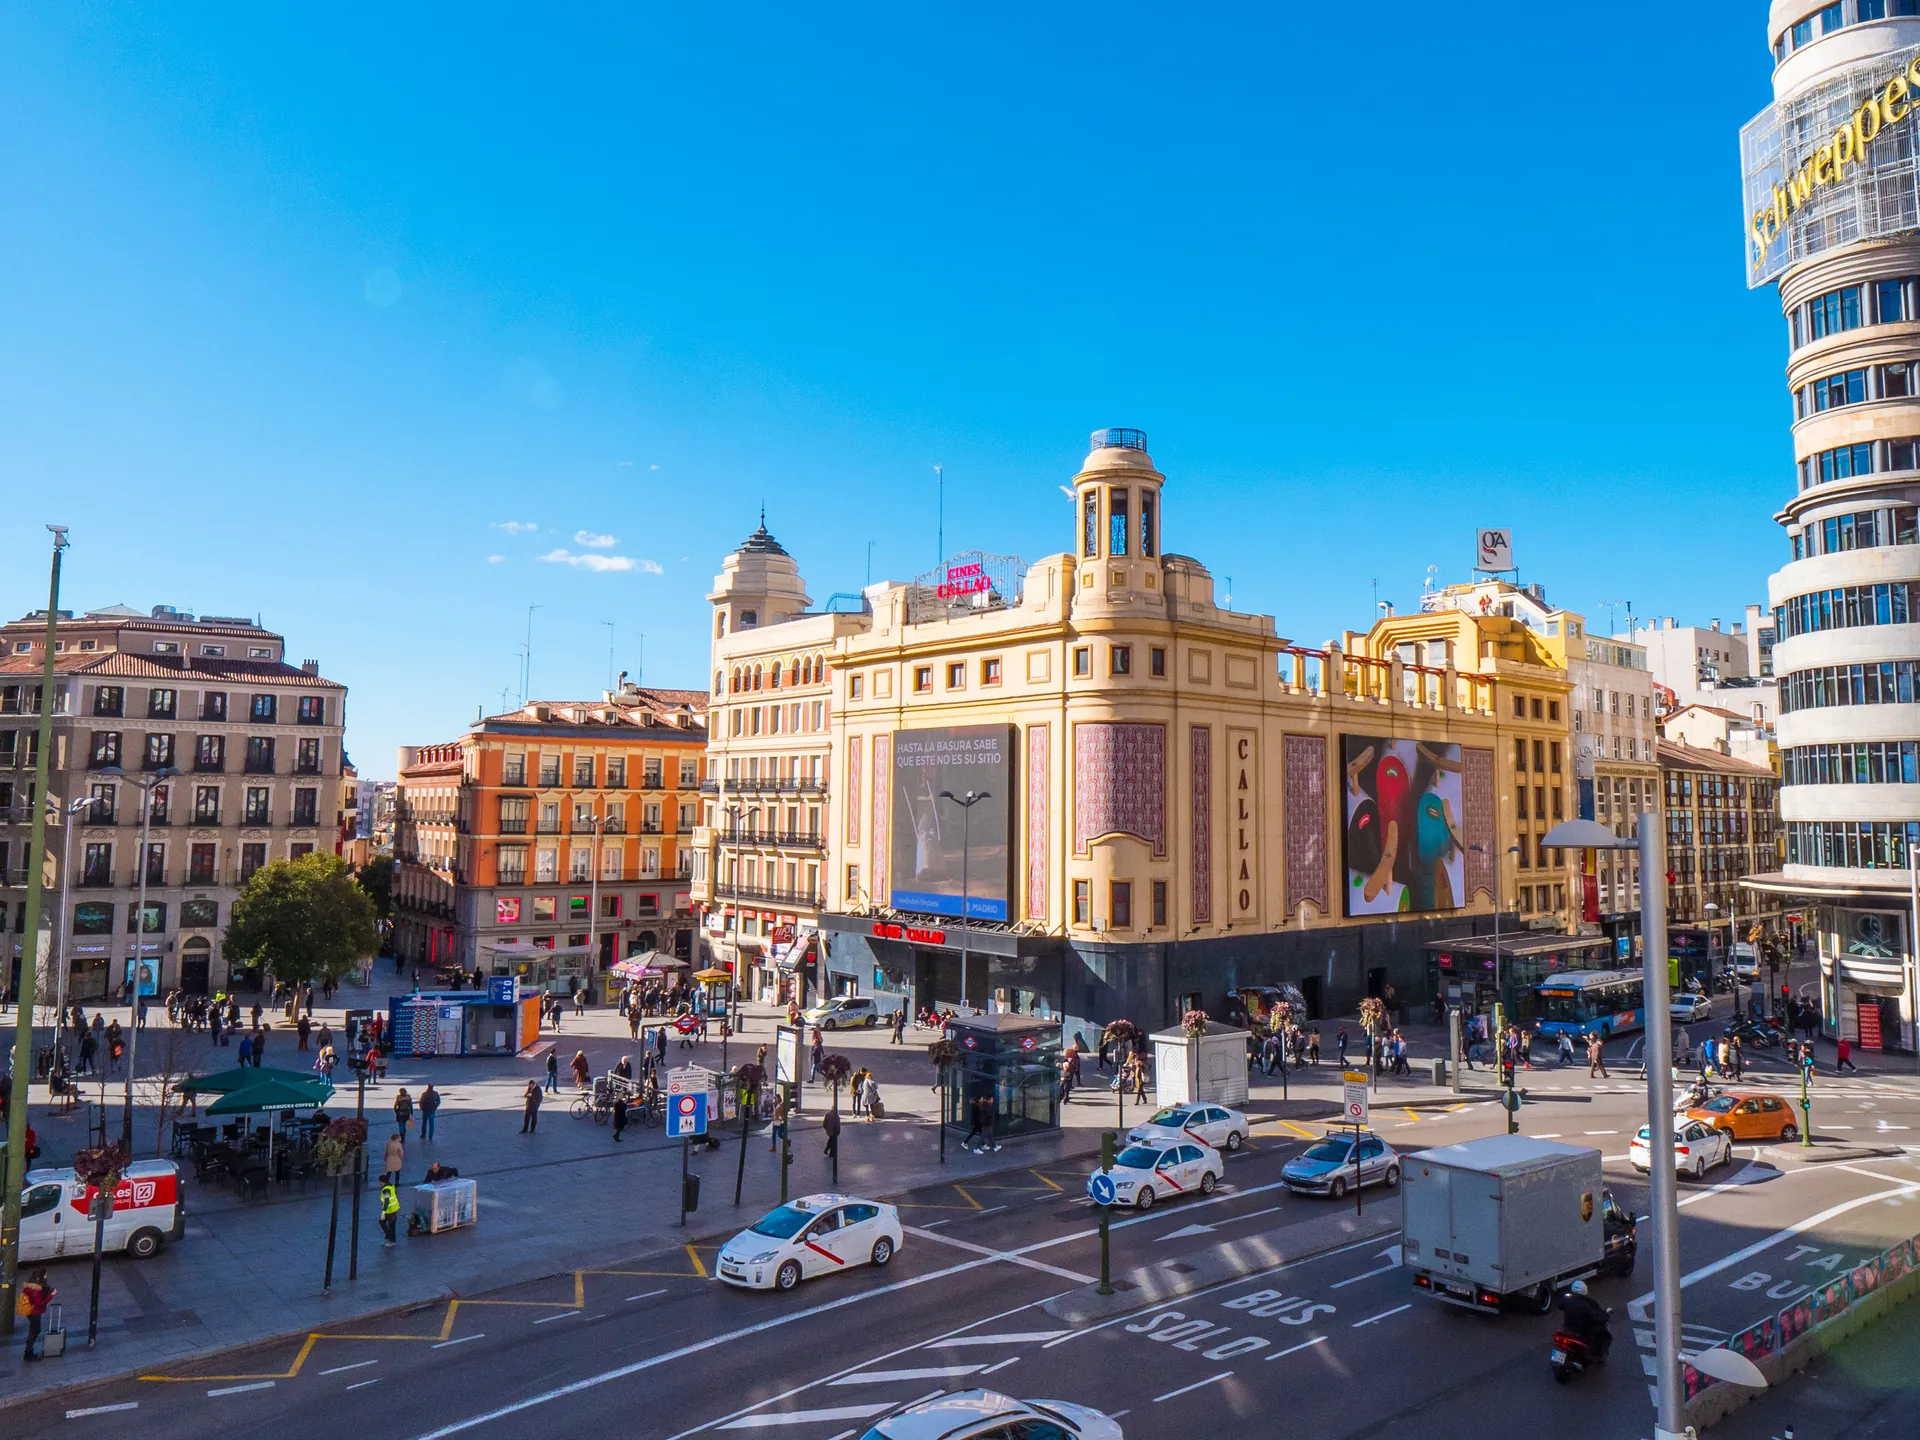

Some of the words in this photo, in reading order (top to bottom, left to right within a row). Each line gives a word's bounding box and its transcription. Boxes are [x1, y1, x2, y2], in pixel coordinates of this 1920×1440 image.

[947, 562, 981, 580] CINES
[937, 574, 991, 599] CALLAO
[897, 742, 923, 753] HASTA
[924, 742, 935, 752] LA
[937, 740, 972, 751] BASURA
[974, 738, 997, 750] SABE
[897, 755, 914, 768] QUE
[915, 755, 935, 766] ESTE
[937, 755, 950, 765] NO
[952, 754, 962, 764] ES
[964, 754, 976, 764] SU
[977, 752, 1001, 764] SITIO
[1238, 738, 1250, 911] CALLAO
[872, 923, 902, 939] CINES
[906, 928, 945, 944] CALLAO
[130, 943, 158, 951] Dsigual
[502, 980, 512, 1001] 0.18
[1220, 1288, 1337, 1325] BUS
[1124, 1311, 1271, 1361] SOLO
